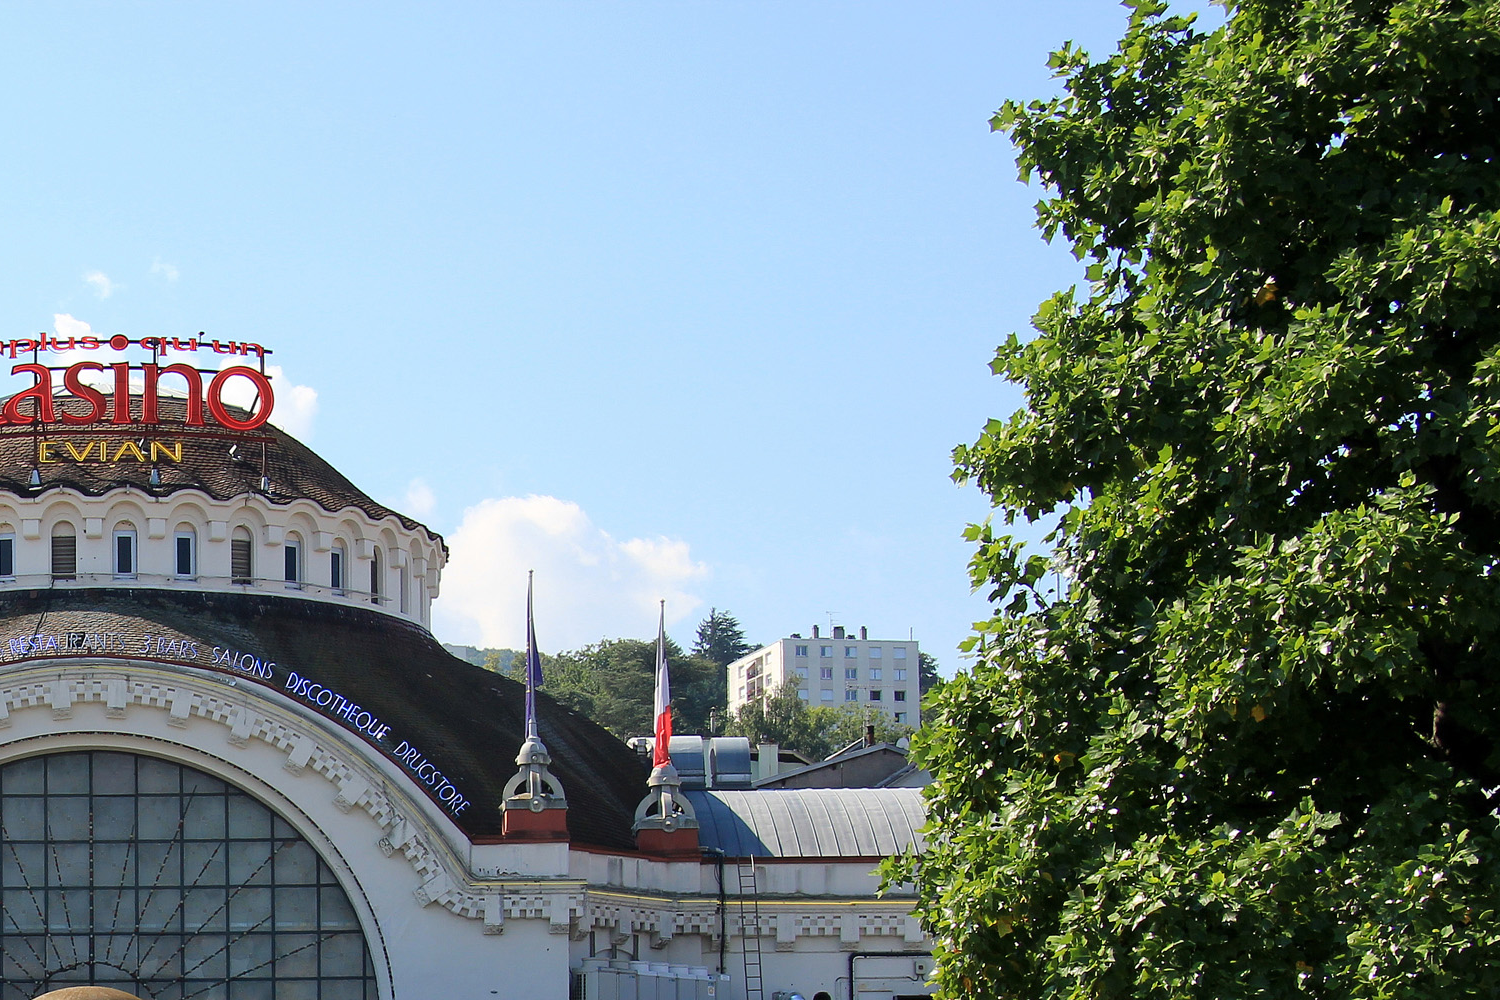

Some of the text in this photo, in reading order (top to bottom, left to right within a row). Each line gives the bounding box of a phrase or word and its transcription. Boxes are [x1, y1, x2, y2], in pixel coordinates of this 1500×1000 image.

[8, 333, 101, 359] plus
[38, 440, 183, 463] EVIAN
[9, 632, 126, 655] RESTAURANTS
[138, 635, 151, 654] 3
[156, 636, 198, 660] BARS
[211, 646, 276, 680] SALONS
[284, 671, 392, 742] DISCOTHEQUE
[393, 740, 471, 816] DRUGSTORE
